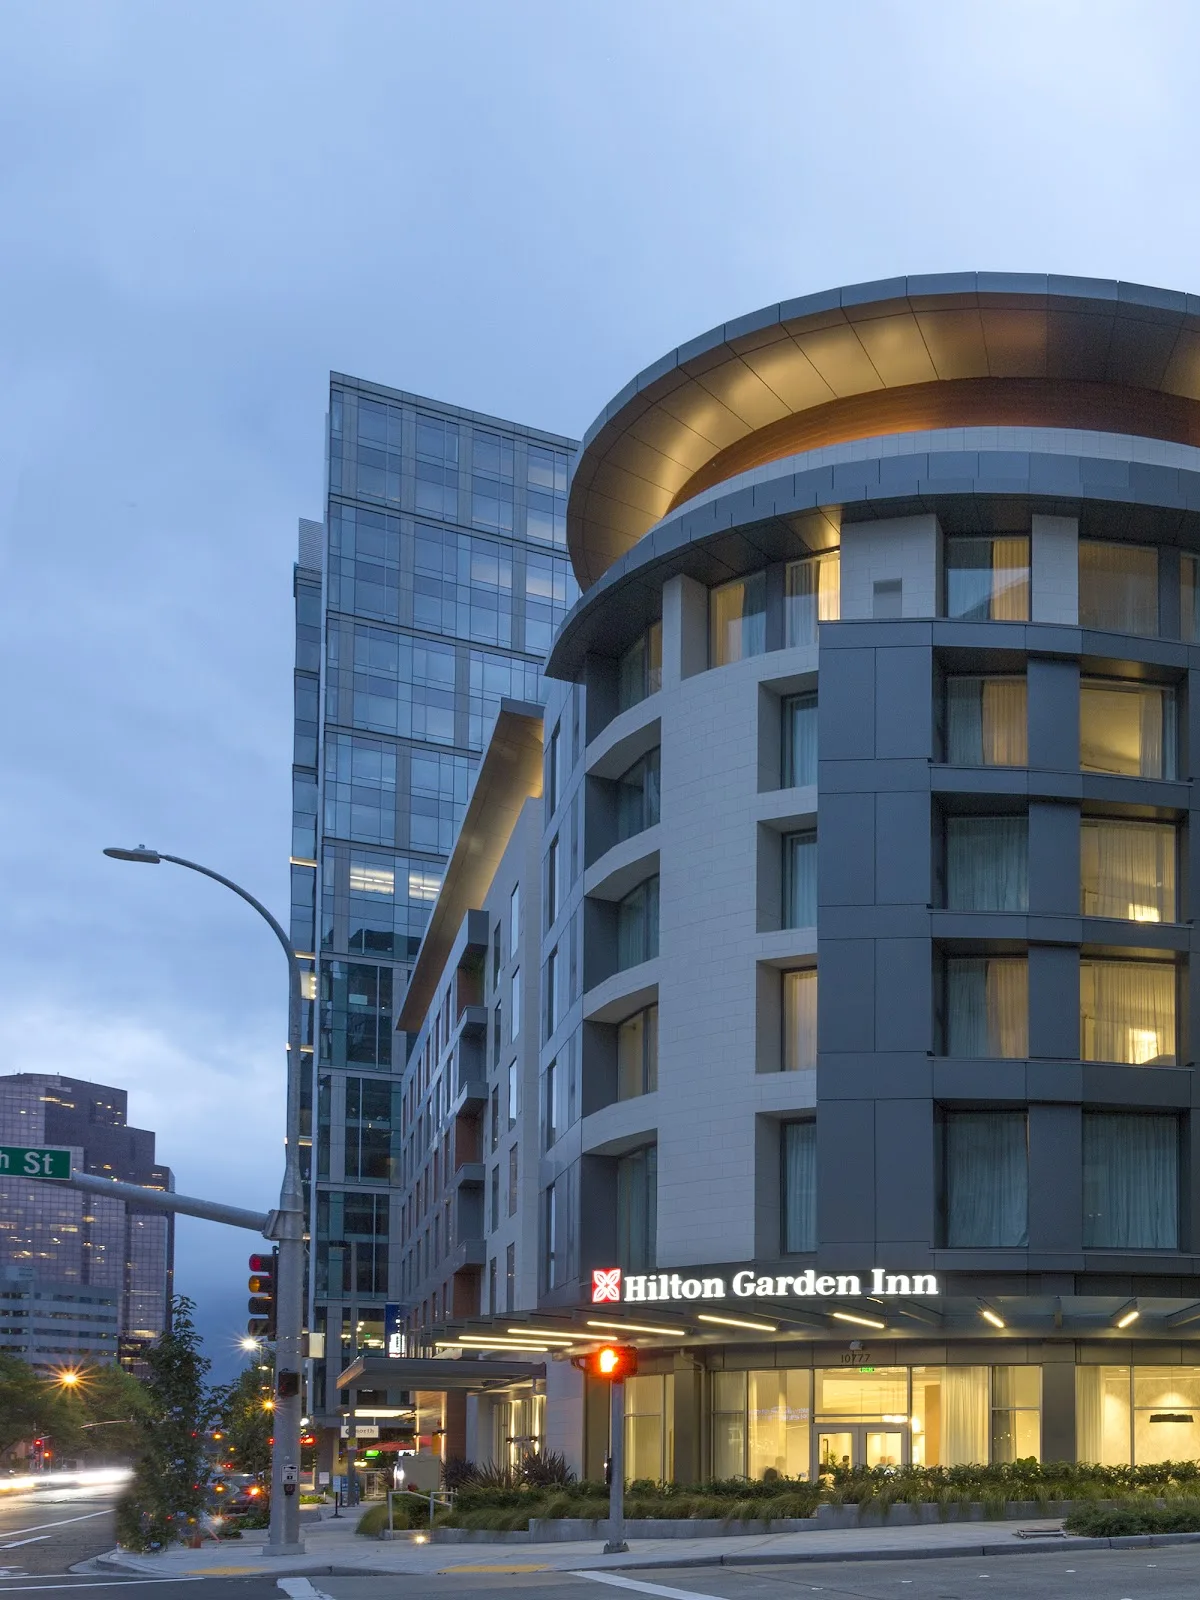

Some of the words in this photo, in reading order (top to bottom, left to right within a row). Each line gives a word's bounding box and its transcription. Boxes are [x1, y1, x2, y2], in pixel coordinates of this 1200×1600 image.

[23, 1151, 54, 1175] St
[624, 1274, 726, 1302] Hilton
[732, 1269, 862, 1297] Garden
[870, 1268, 939, 1295] Inn
[841, 1353, 871, 1363] 10777
